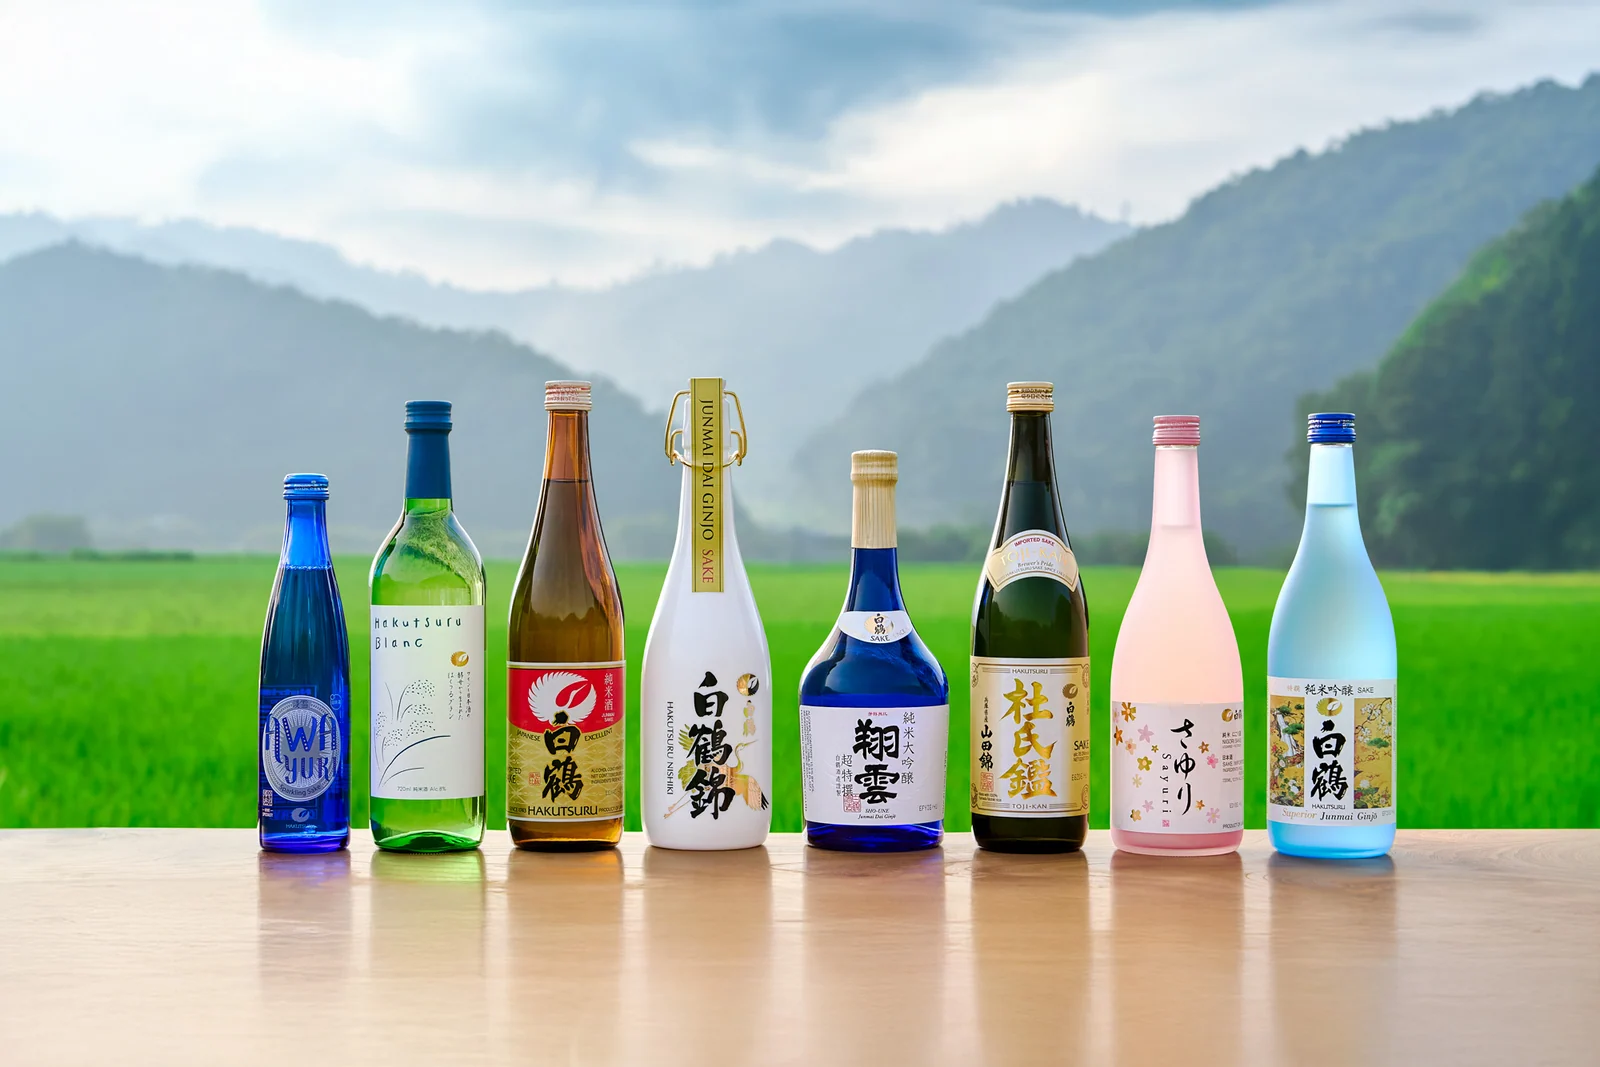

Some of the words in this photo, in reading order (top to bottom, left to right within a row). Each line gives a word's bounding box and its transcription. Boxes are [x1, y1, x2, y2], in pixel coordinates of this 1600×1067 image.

[699, 400, 714, 456] JUNMAI
[702, 462, 714, 487] DAI
[700, 493, 714, 541] GINJO
[1014, 537, 1040, 547] IMPORTED
[1042, 537, 1055, 547] SAKE
[702, 549, 714, 583] SAKE
[374, 616, 462, 630] Hakutsuru
[874, 613, 886, 634] 白鶴
[375, 636, 423, 650] Blanc
[604, 672, 614, 711] 純米酒
[1304, 684, 1354, 697] 純米吟醸
[265, 714, 337, 764] AWA
[516, 729, 541, 742] JAPANESE
[584, 728, 613, 742] EXCELLENT
[666, 701, 674, 759] HAKUTSURU
[685, 671, 736, 820] 白鶴錦
[901, 711, 916, 785] 純米大吟醸
[979, 724, 994, 772] 山田錦
[999, 678, 1058, 799] 杜氏鑑
[1074, 740, 1089, 750] SAKE
[284, 754, 337, 784] YURI
[542, 710, 584, 802] 白鶴
[852, 719, 900, 804] 翔雲
[1170, 718, 1196, 815] さゆり
[1311, 720, 1349, 801] 白鶴
[279, 784, 307, 796] Sparkling
[306, 784, 321, 794] Sake
[666, 762, 674, 795] NISHIKI
[1160, 753, 1172, 813] Sayuri
[527, 805, 598, 817] HAKUTSURU
[1282, 808, 1317, 819] Superior
[1320, 811, 1354, 820] Junmai
